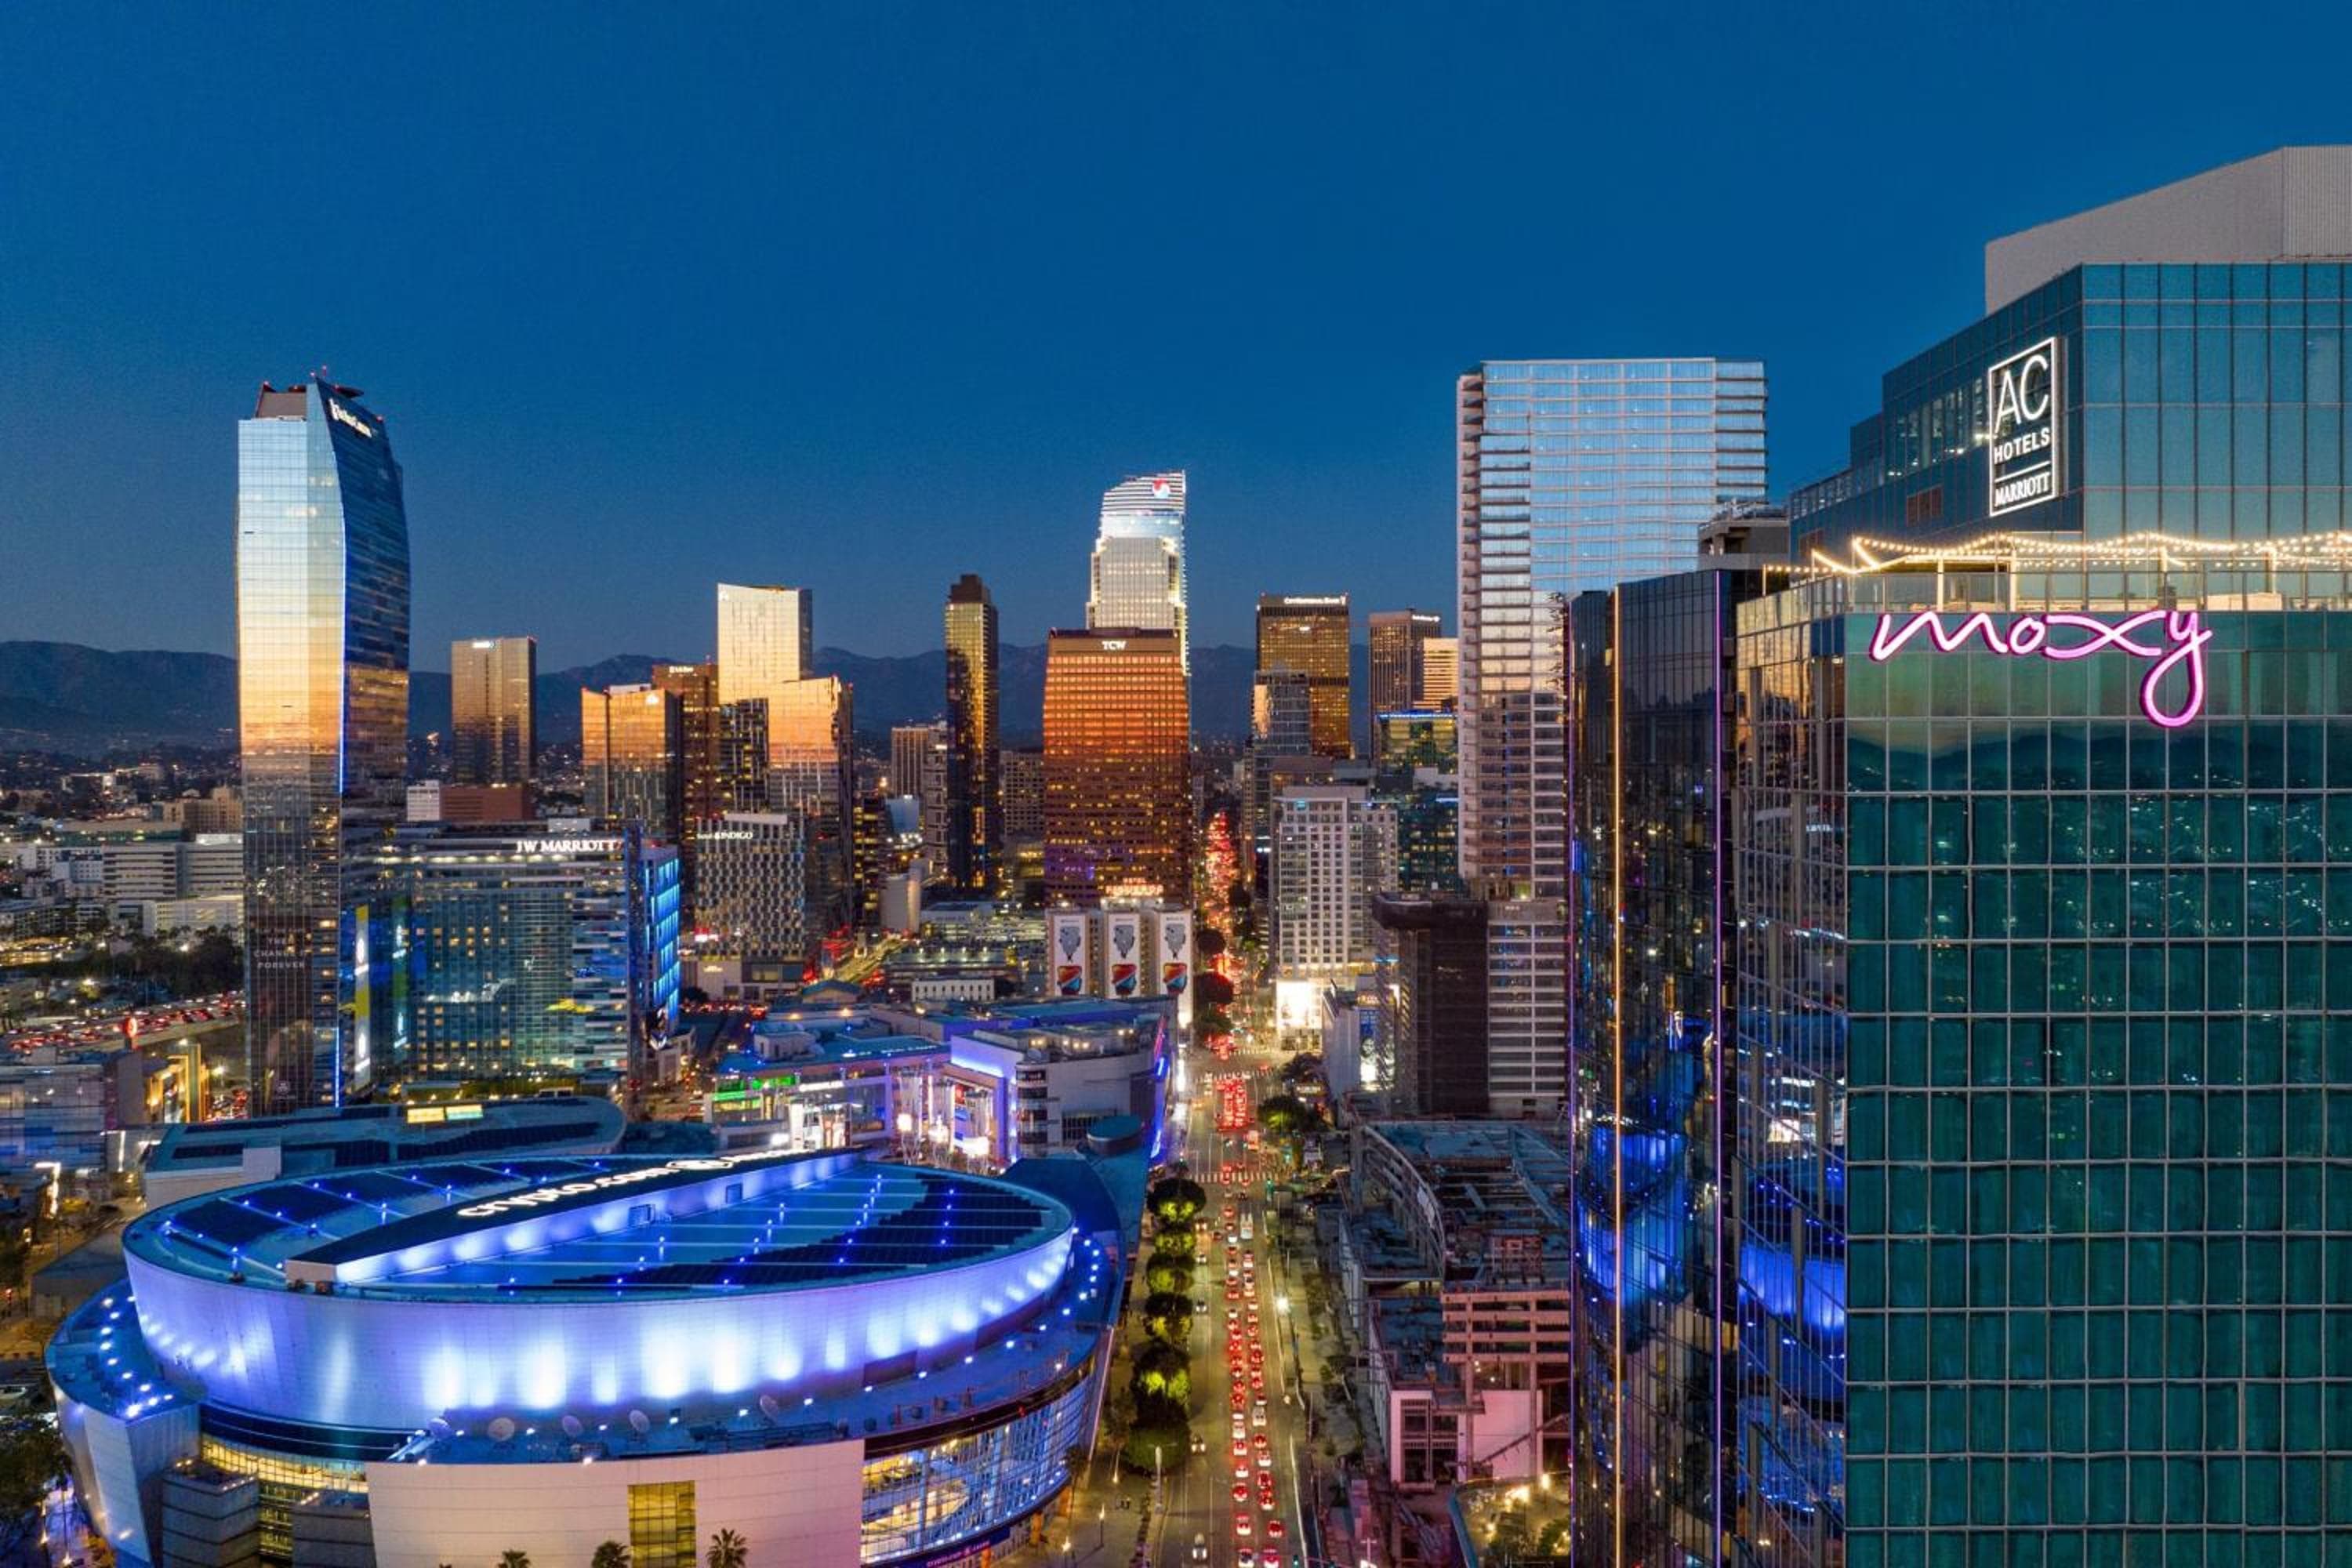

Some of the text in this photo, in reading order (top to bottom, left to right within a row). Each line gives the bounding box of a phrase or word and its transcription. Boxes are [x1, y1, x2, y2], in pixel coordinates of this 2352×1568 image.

[1994, 354, 2049, 434] AC
[1994, 427, 2050, 465] HOTELS
[1994, 471, 2051, 507] MARRIOTT
[1102, 640, 1127, 650] TCW
[1869, 611, 2212, 728] moxy
[516, 840, 618, 853] JW MARRIOTT
